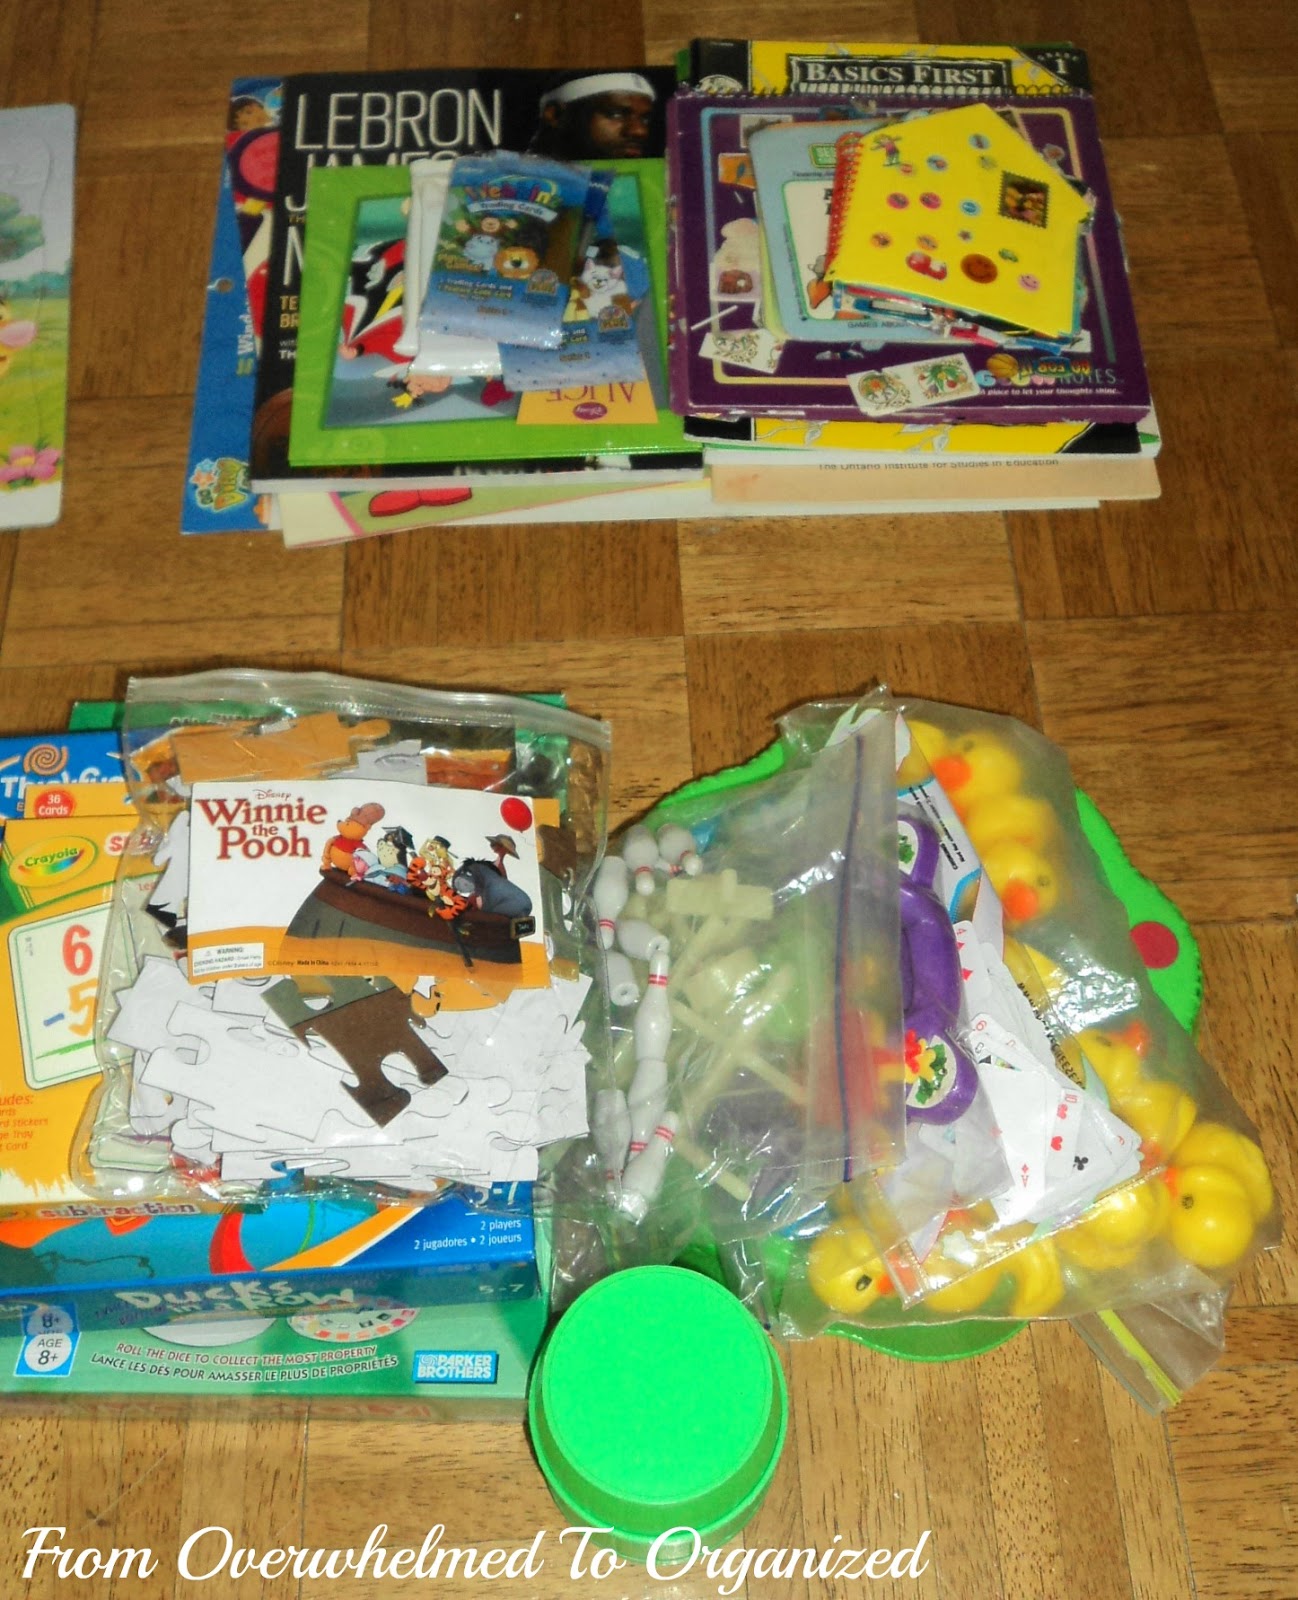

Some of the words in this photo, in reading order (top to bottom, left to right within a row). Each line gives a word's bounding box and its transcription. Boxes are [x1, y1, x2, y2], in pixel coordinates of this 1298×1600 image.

[806, 62, 904, 83] BASICS
[914, 64, 995, 84] FIRST
[295, 88, 501, 149] LEBRON
[47, 793, 61, 804] 36
[38, 804, 69, 816] Cards
[195, 797, 328, 825] Winnie
[252, 824, 279, 837] the
[217, 825, 312, 860] Pooh
[24, 846, 79, 869] Crayola
[62, 924, 93, 976] 6
[40, 1202, 196, 1218] subtraction
[480, 1220, 486, 1230] 2
[489, 1219, 522, 1232] players
[414, 1240, 420, 1250] 2
[422, 1237, 468, 1251] jugadores
[480, 1235, 486, 1245] 2
[488, 1234, 522, 1246] joueurs
[37, 1338, 63, 1348] AGE
[38, 1350, 58, 1365] 8+
[117, 1343, 142, 1355] ROLL
[146, 1348, 165, 1359] THE
[168, 1351, 191, 1362] DICE
[195, 1354, 209, 1364] TO
[213, 1355, 259, 1366] COLLECT
[262, 1356, 282, 1366] THE
[285, 1353, 317, 1364] MOST
[320, 1345, 377, 1361] PROPERTY
[437, 1354, 493, 1367] PARKER
[91, 1353, 124, 1369] LANCE
[128, 1361, 147, 1373] LES
[173, 1367, 205, 1379] POUR
[207, 1371, 261, 1381] AMASSER
[265, 1371, 277, 1381] LE
[280, 1369, 308, 1381] PLUS
[312, 1367, 326, 1378] DE
[330, 1355, 398, 1376] PROPRIÉTÉS
[417, 1366, 492, 1378] BROTHERS
